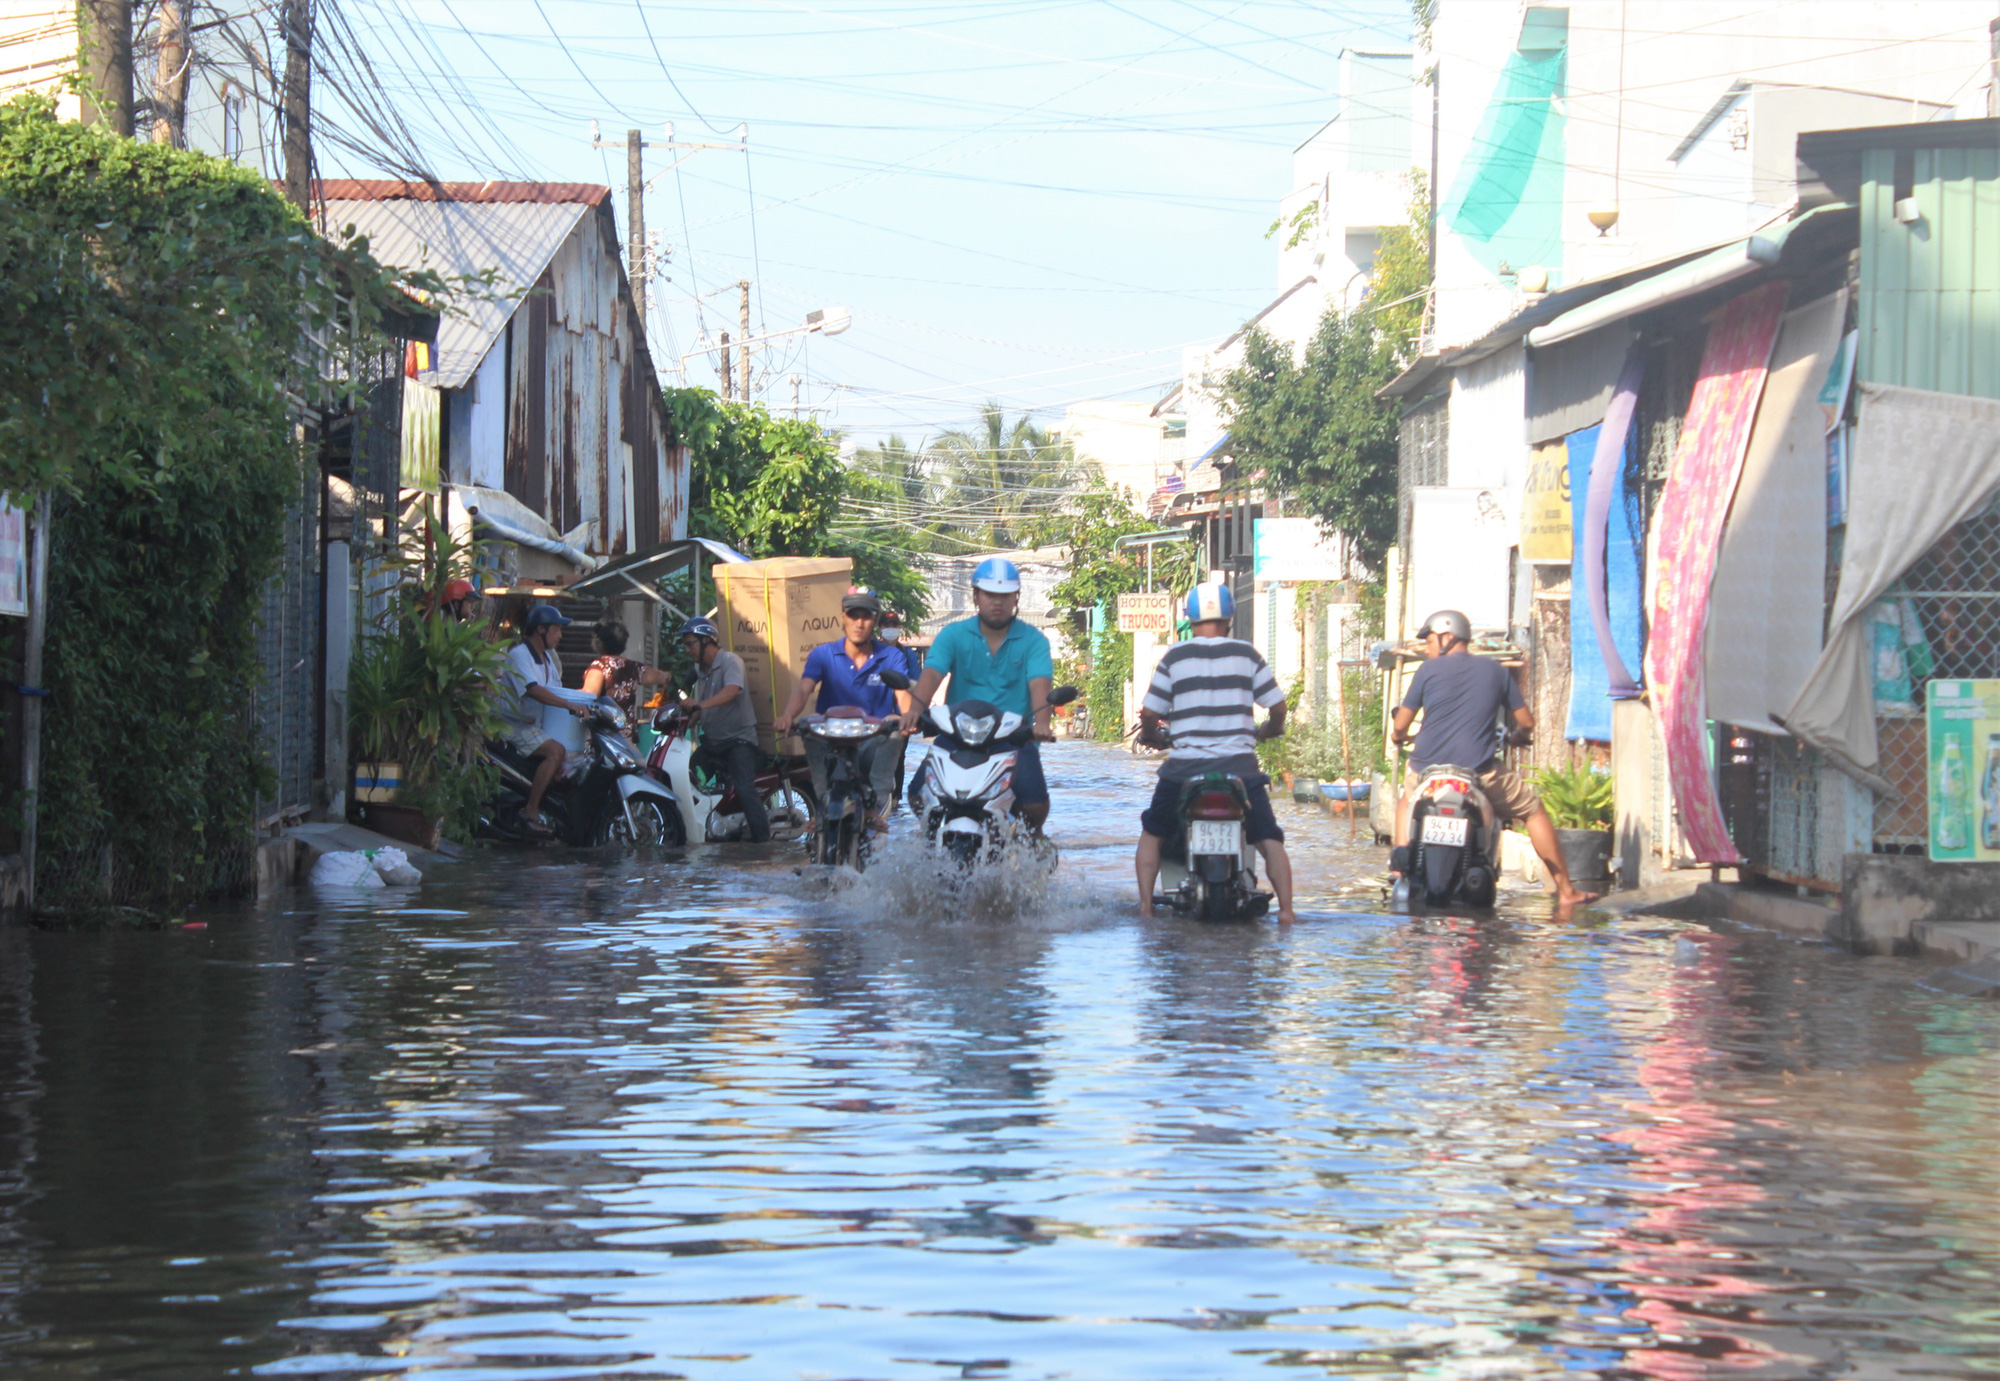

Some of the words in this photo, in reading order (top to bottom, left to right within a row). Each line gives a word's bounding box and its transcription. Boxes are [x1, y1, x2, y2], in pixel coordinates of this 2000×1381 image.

[737, 620, 768, 633] AQUA
[802, 616, 840, 632] AQUA
[1200, 823, 1232, 836] 94-F2
[1431, 818, 1459, 831] 94-K1
[1200, 838, 1232, 852] 2921
